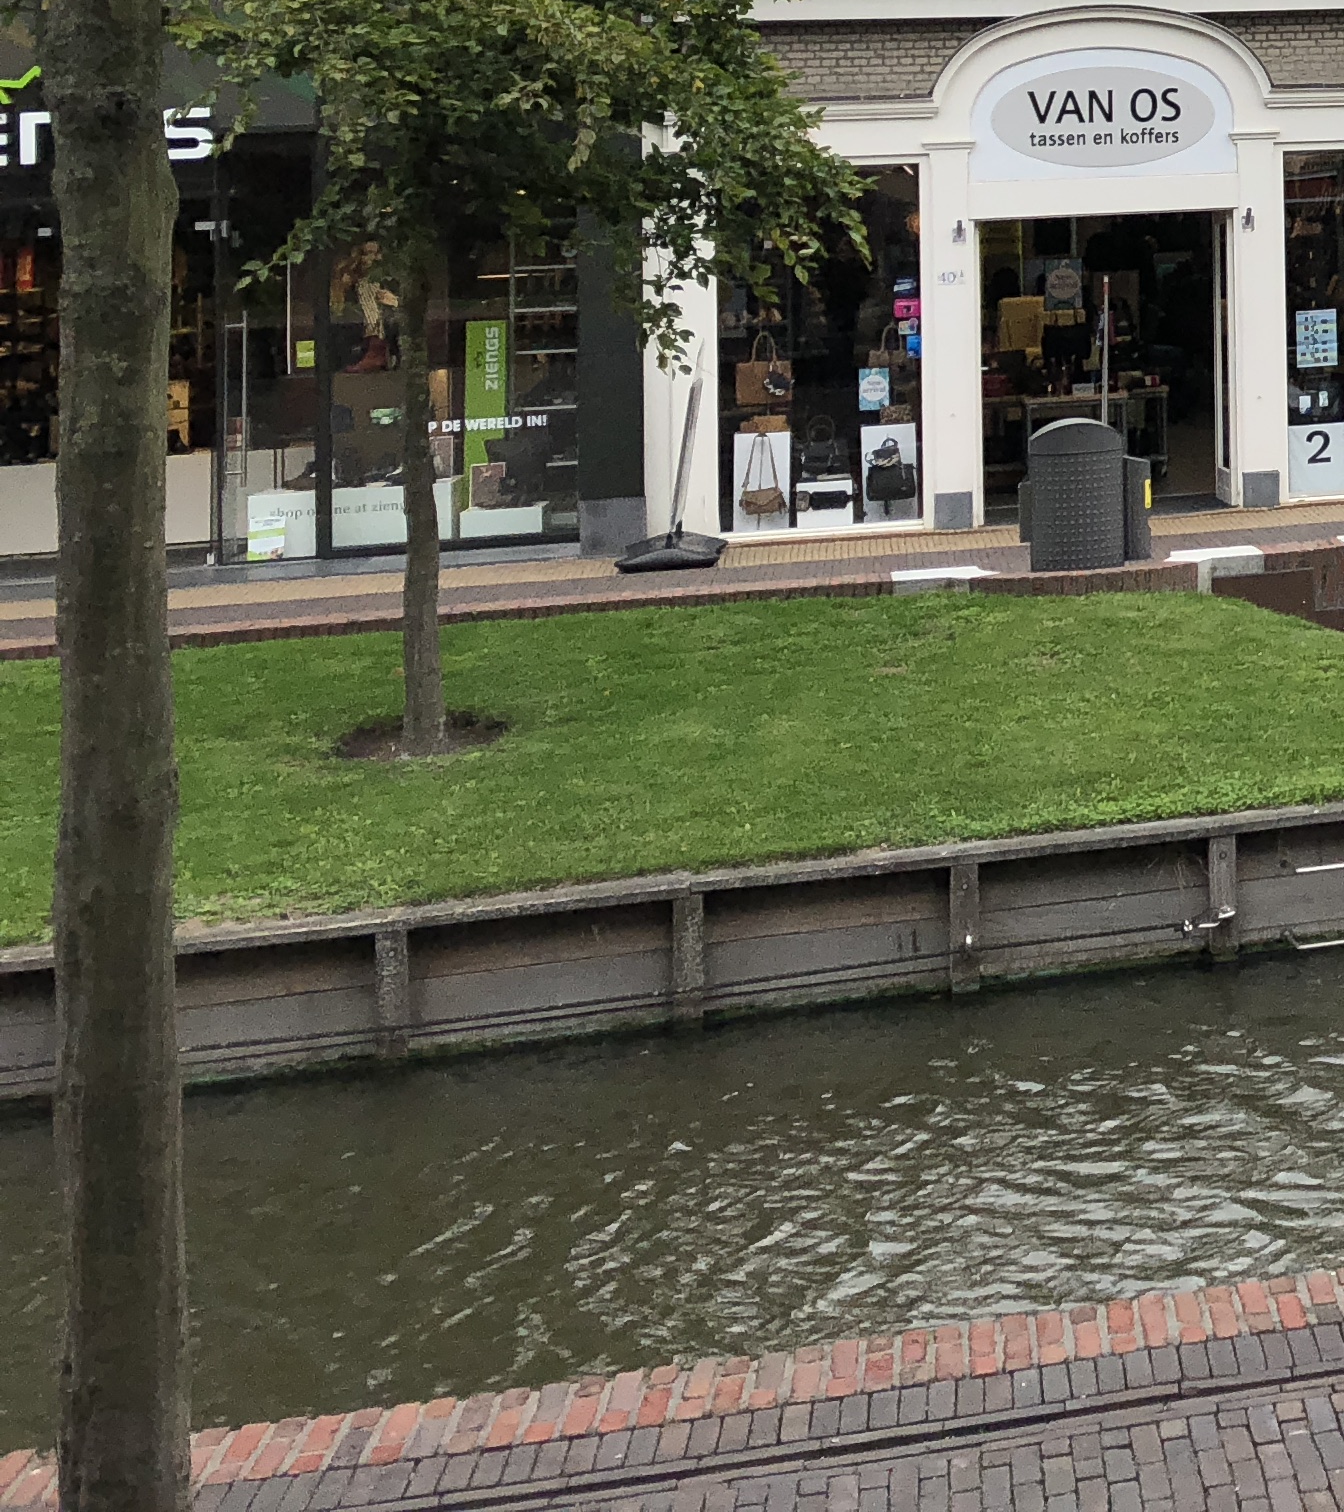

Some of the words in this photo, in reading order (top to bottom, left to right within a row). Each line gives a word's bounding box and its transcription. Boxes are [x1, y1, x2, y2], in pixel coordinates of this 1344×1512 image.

[1027, 89, 1114, 124] VAN
[1130, 88, 1182, 123] OS
[1029, 131, 1086, 147] tassen
[1093, 132, 1113, 146] en
[1120, 127, 1179, 145] koffers
[441, 420, 461, 433] DE
[465, 416, 523, 431] WERELD
[526, 414, 548, 427] IN!
[1305, 430, 1332, 465] 2
